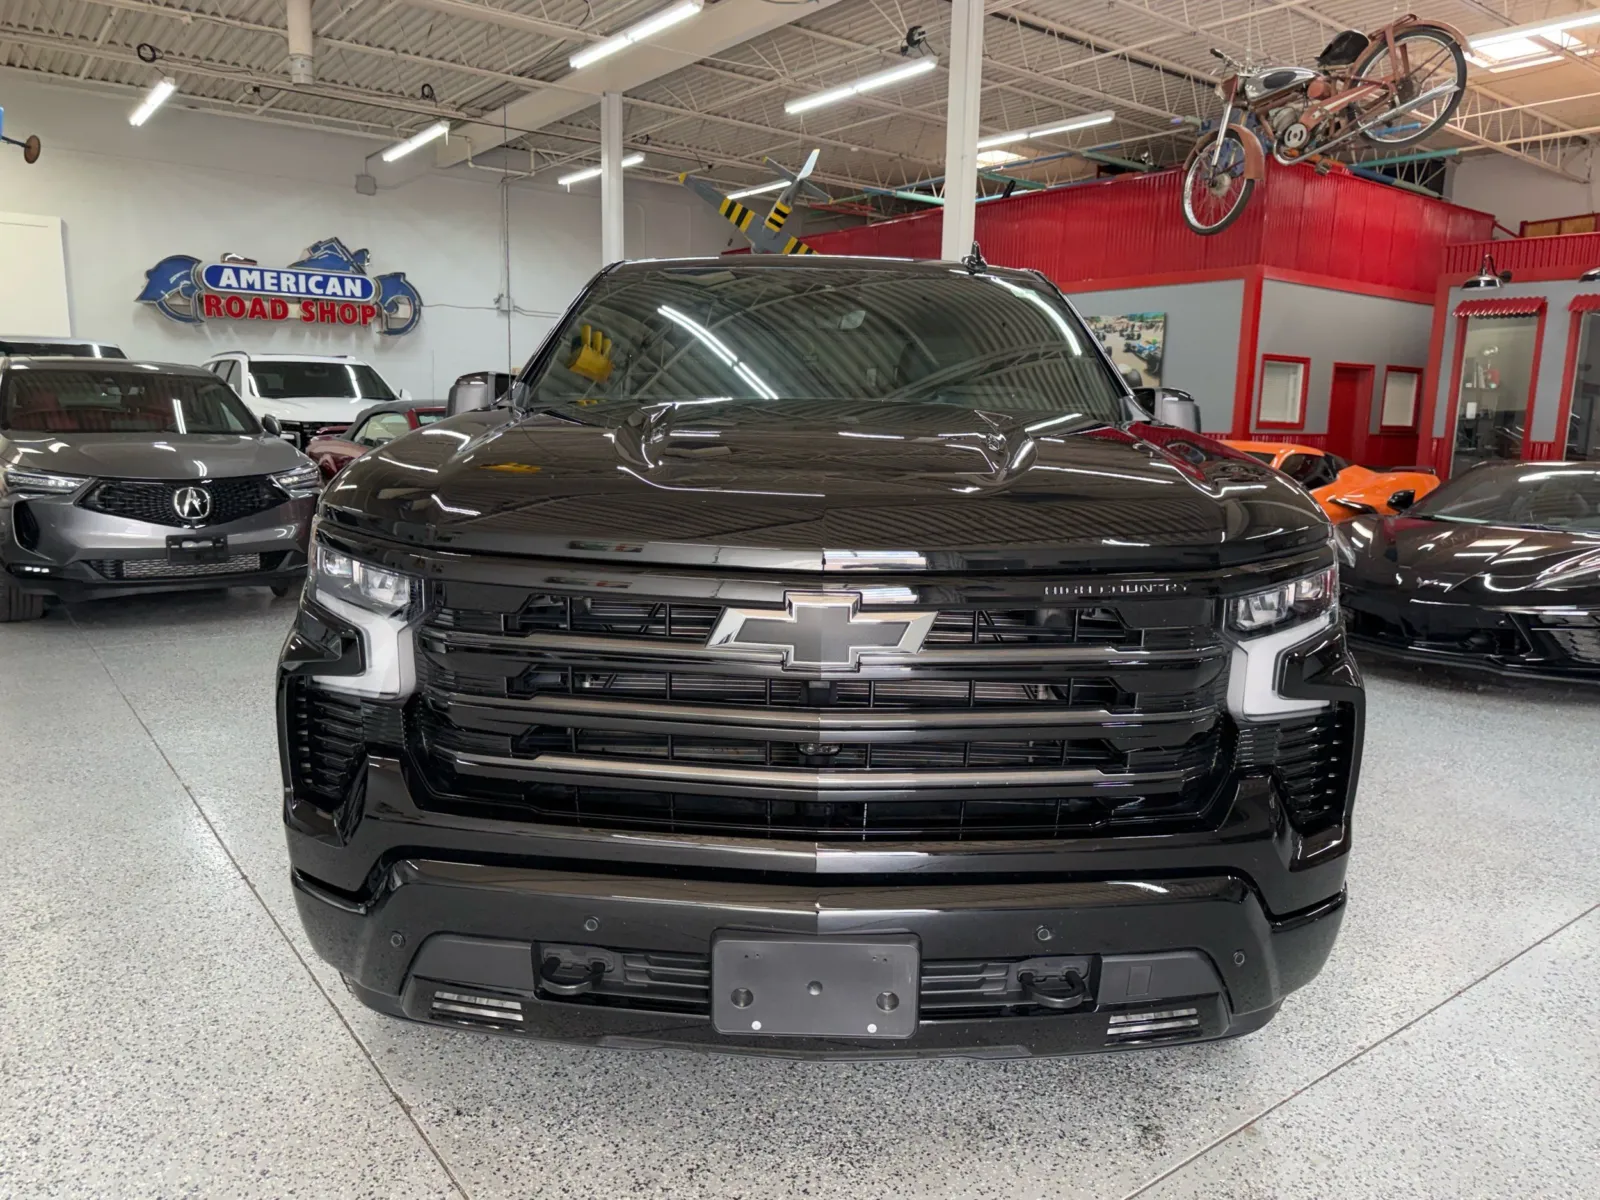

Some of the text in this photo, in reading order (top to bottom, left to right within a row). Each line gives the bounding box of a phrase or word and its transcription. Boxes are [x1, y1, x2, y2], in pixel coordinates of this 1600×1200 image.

[218, 268, 363, 297] AMERICAN
[203, 294, 377, 326] ROAD SHOP
